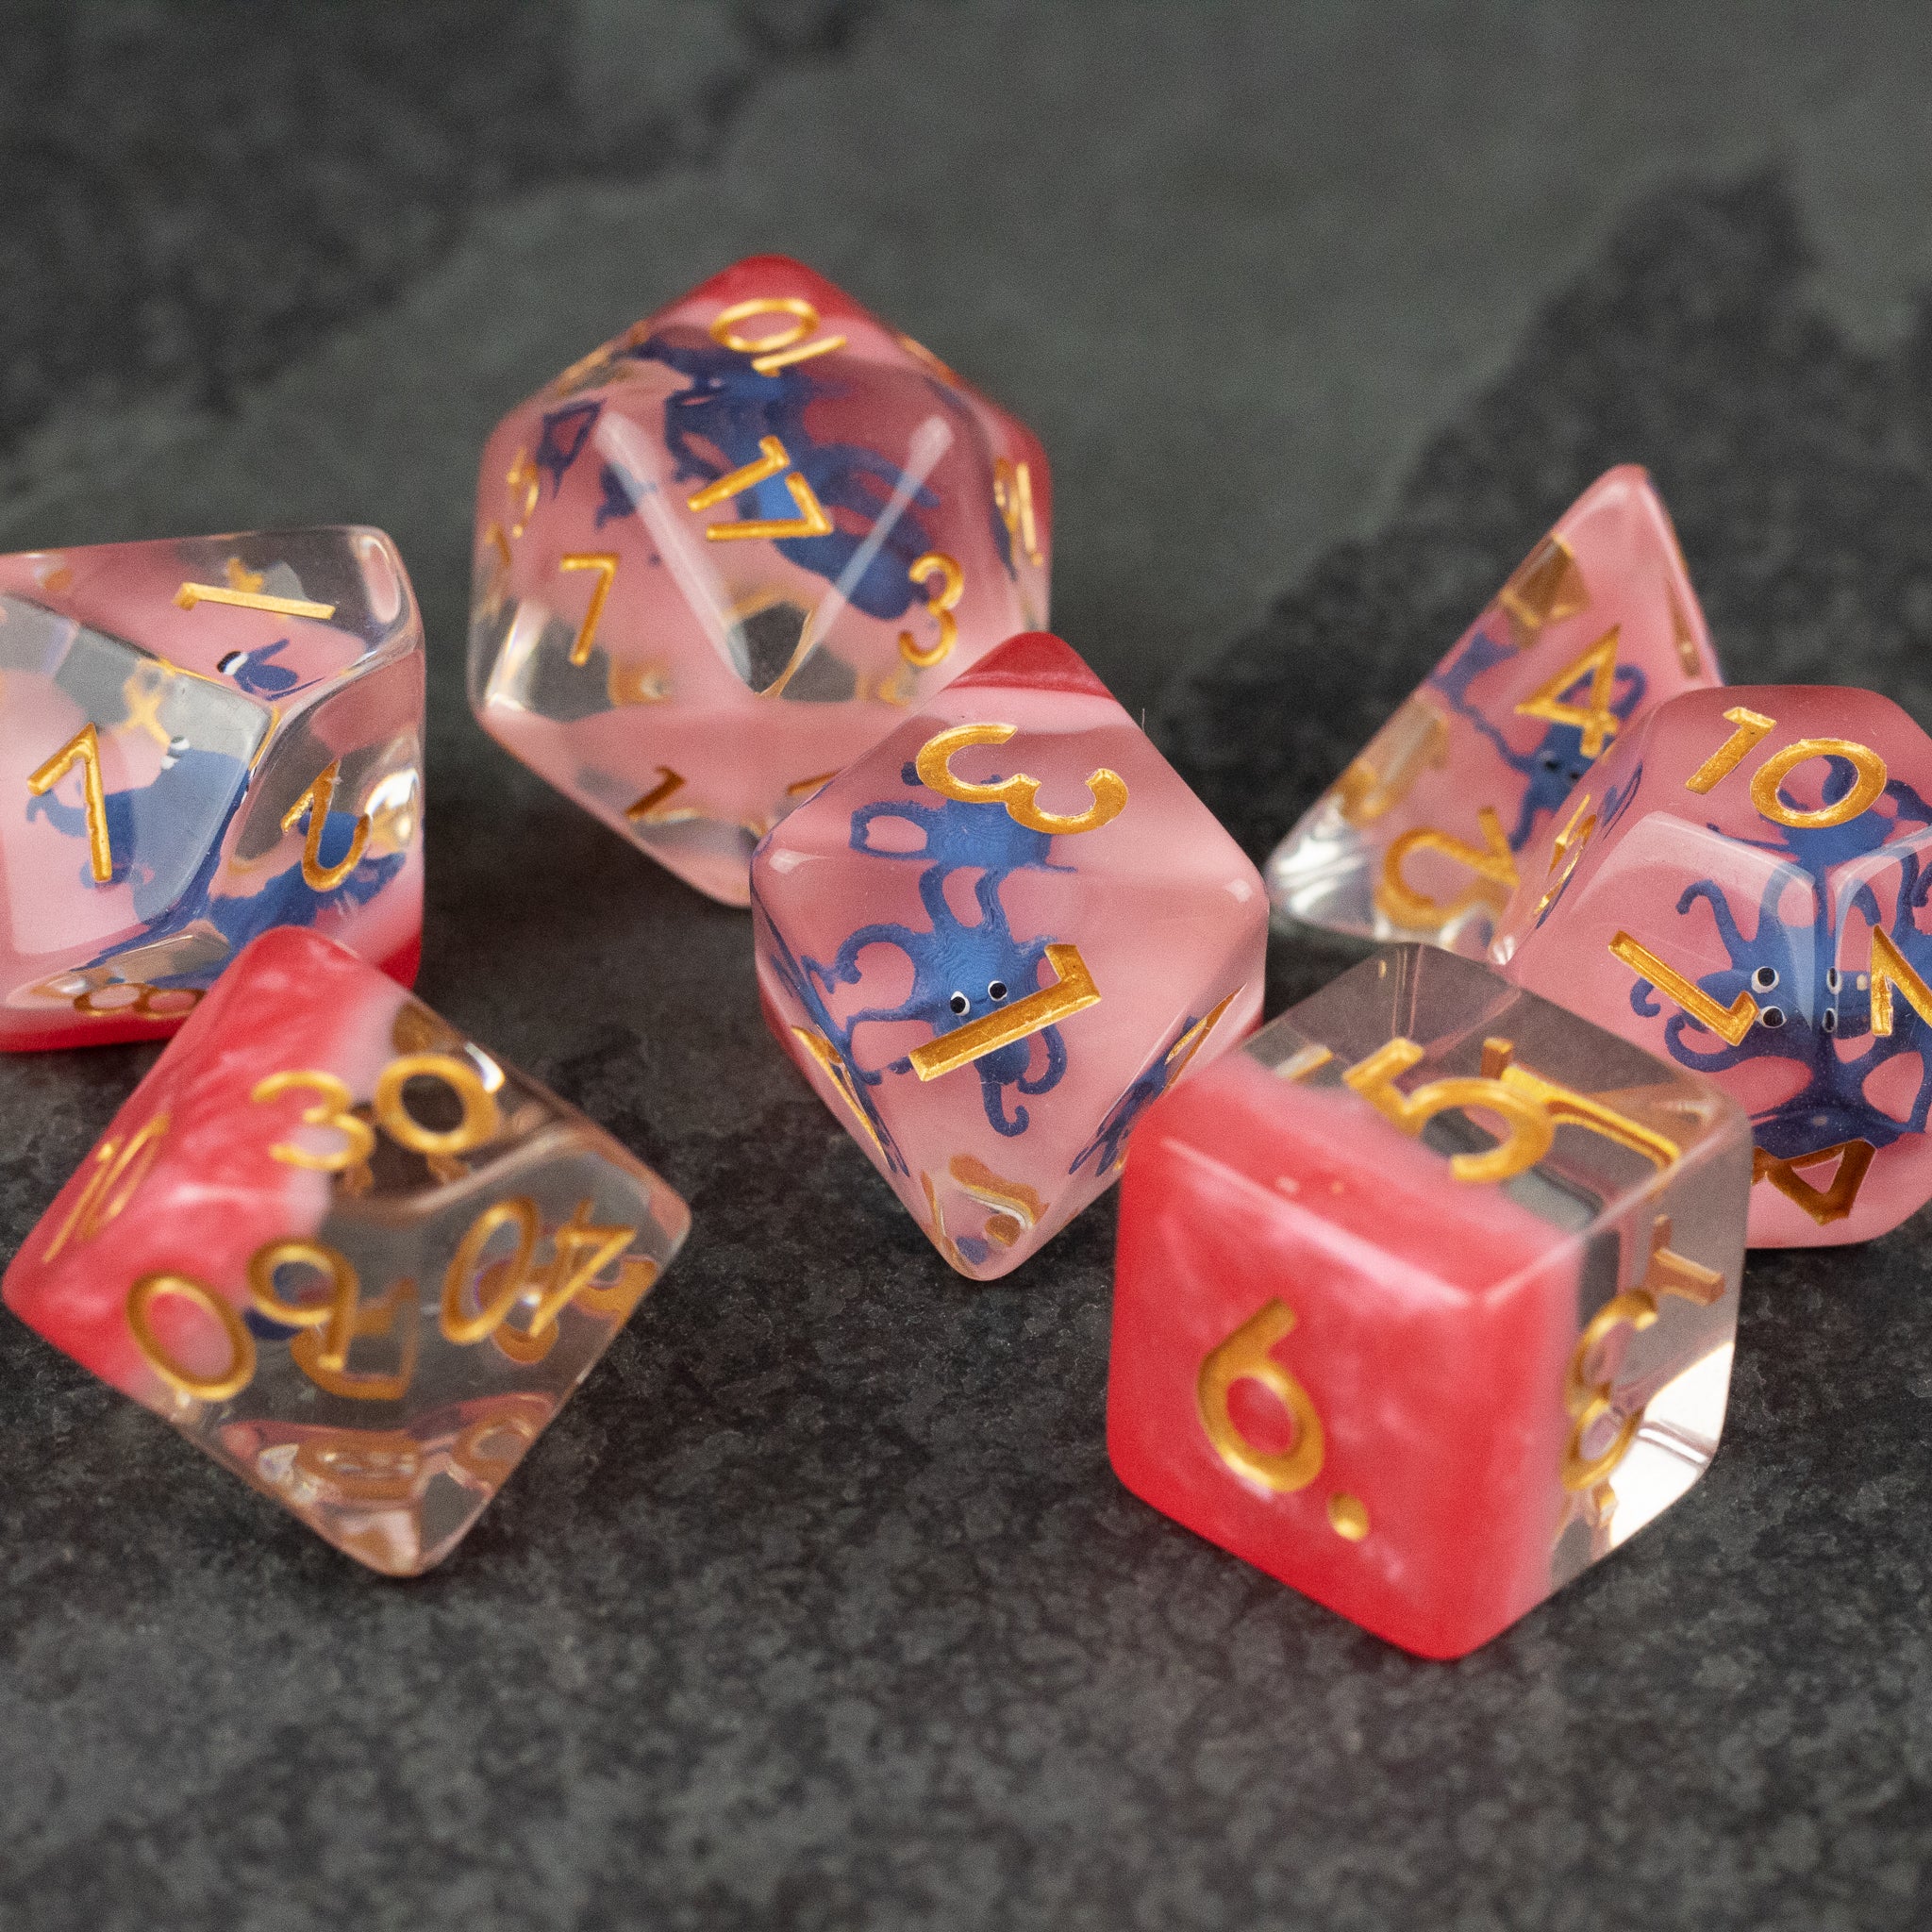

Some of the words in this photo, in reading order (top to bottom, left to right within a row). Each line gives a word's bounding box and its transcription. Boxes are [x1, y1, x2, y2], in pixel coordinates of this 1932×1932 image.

[688, 436, 834, 541] 17
[560, 552, 619, 666] 7
[898, 552, 964, 667] 3
[1513, 623, 1624, 758] 4
[916, 724, 1129, 835] 3
[1686, 707, 1888, 829] 10
[251, 1054, 500, 1172] 30
[1344, 1037, 1555, 1183] 5
